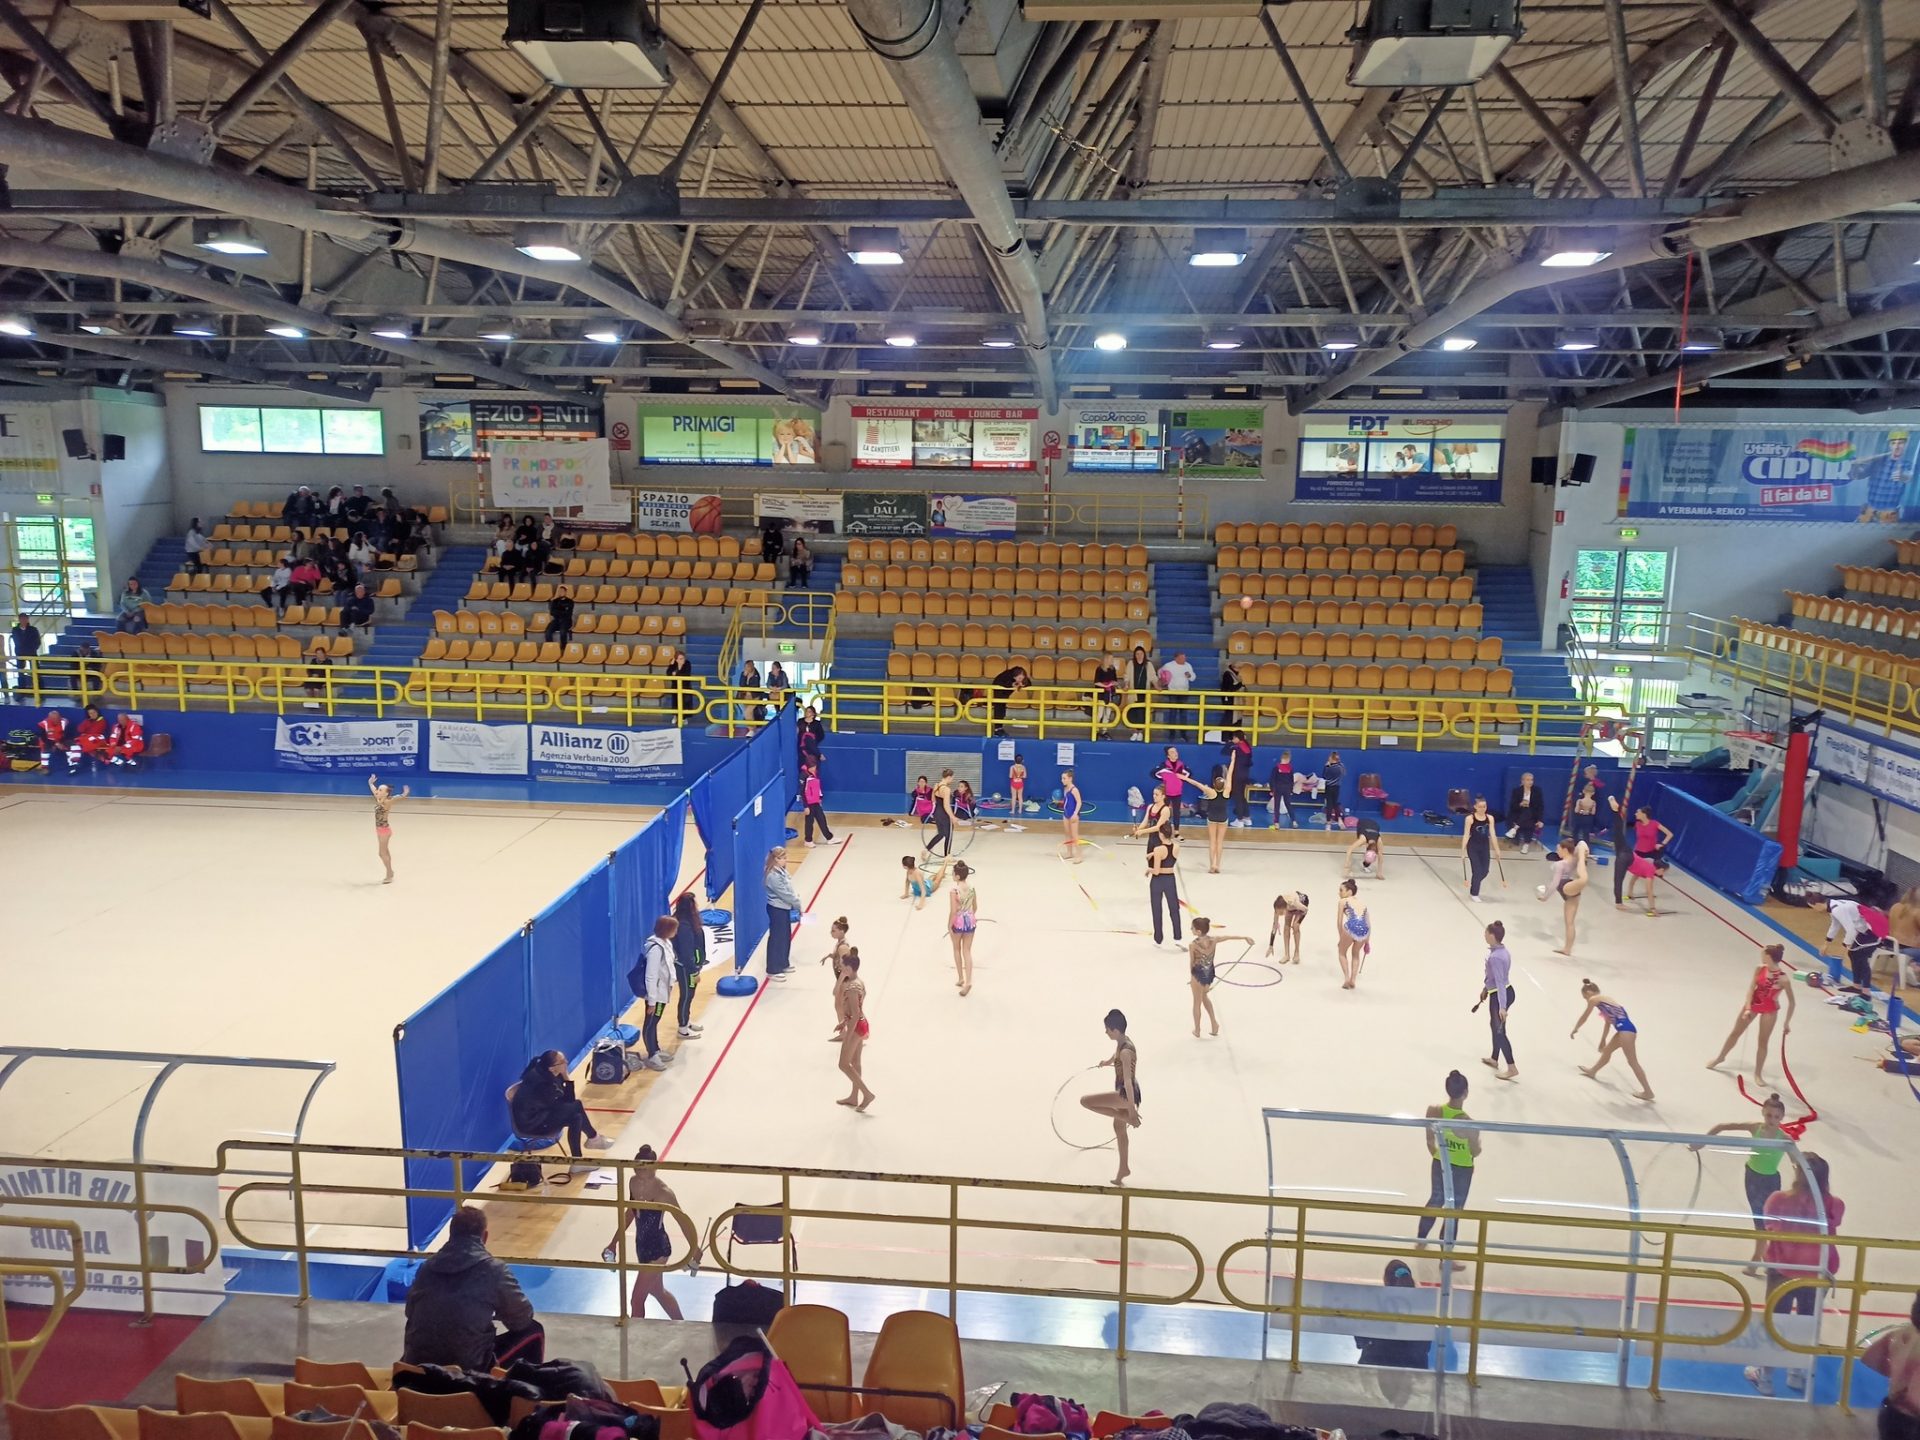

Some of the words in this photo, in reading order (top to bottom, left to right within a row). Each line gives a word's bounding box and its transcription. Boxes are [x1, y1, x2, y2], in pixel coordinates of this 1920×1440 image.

[475, 405, 524, 422] EZIO
[528, 405, 589, 424] DENTI
[866, 408, 921, 417] RESTAURANT
[934, 409, 956, 417] POOL
[968, 409, 1002, 418] LOUNGE
[1006, 410, 1023, 418] BAR
[673, 416, 735, 432] PRIMIGI
[1348, 416, 1389, 430] FDT
[1744, 443, 1792, 457] Utility
[1749, 457, 1852, 480] CIPIR
[643, 493, 688, 504] SPAZIO
[1763, 490, 1773, 503] il
[1775, 488, 1793, 502] fai
[1795, 488, 1812, 501] da
[1814, 488, 1828, 500] te
[643, 507, 688, 518] LIBERO
[1659, 506, 1666, 514] A
[1667, 506, 1746, 515] VERBANIA-RENCO
[439, 724, 476, 732] FARMACIA
[362, 736, 396, 747] SPORT
[451, 732, 482, 743] NAVA
[540, 730, 603, 750] Allianz
[540, 751, 572, 762] Agenzia
[573, 752, 608, 763] Verbania
[609, 755, 630, 764] 2000
[1886, 760, 1896, 771] di
